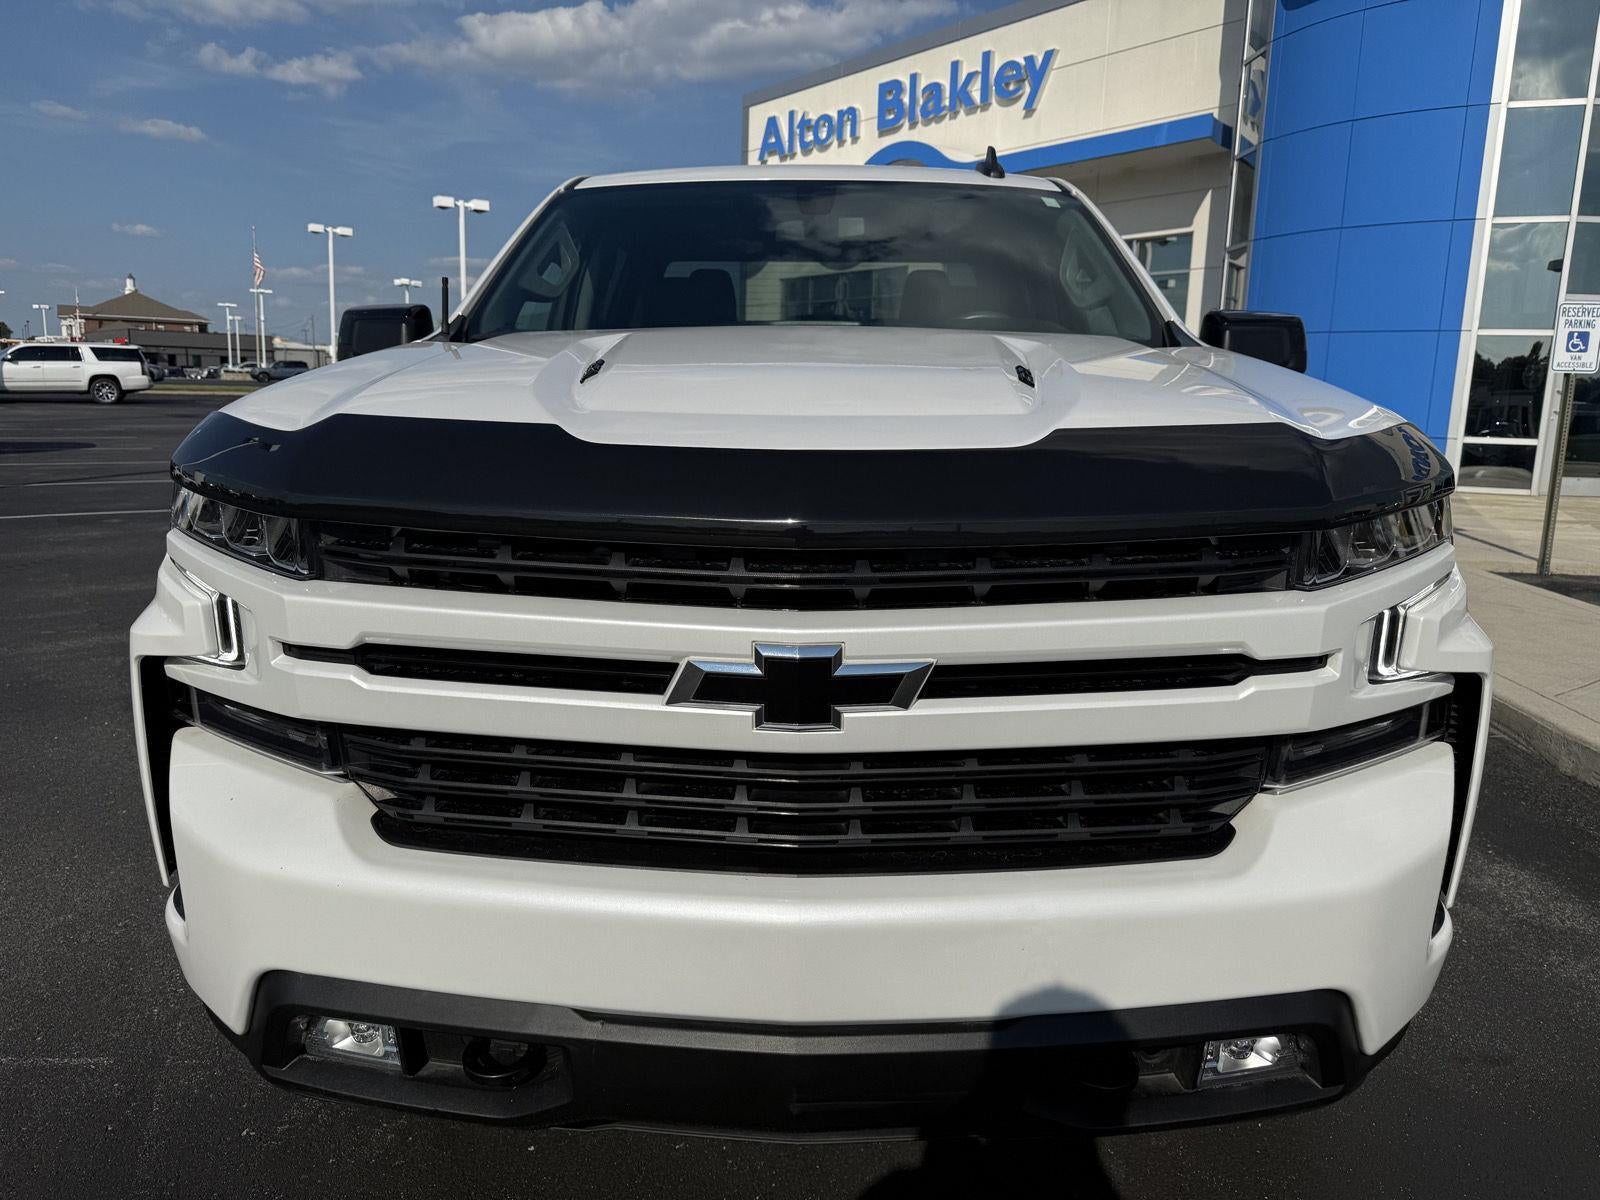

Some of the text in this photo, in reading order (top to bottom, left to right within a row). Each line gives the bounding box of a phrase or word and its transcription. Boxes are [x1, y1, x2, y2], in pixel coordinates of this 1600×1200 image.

[758, 48, 1056, 161] Alton Blakley
[1564, 319, 1596, 329] PARKING
[1557, 361, 1593, 369] ACCESSIBLE
